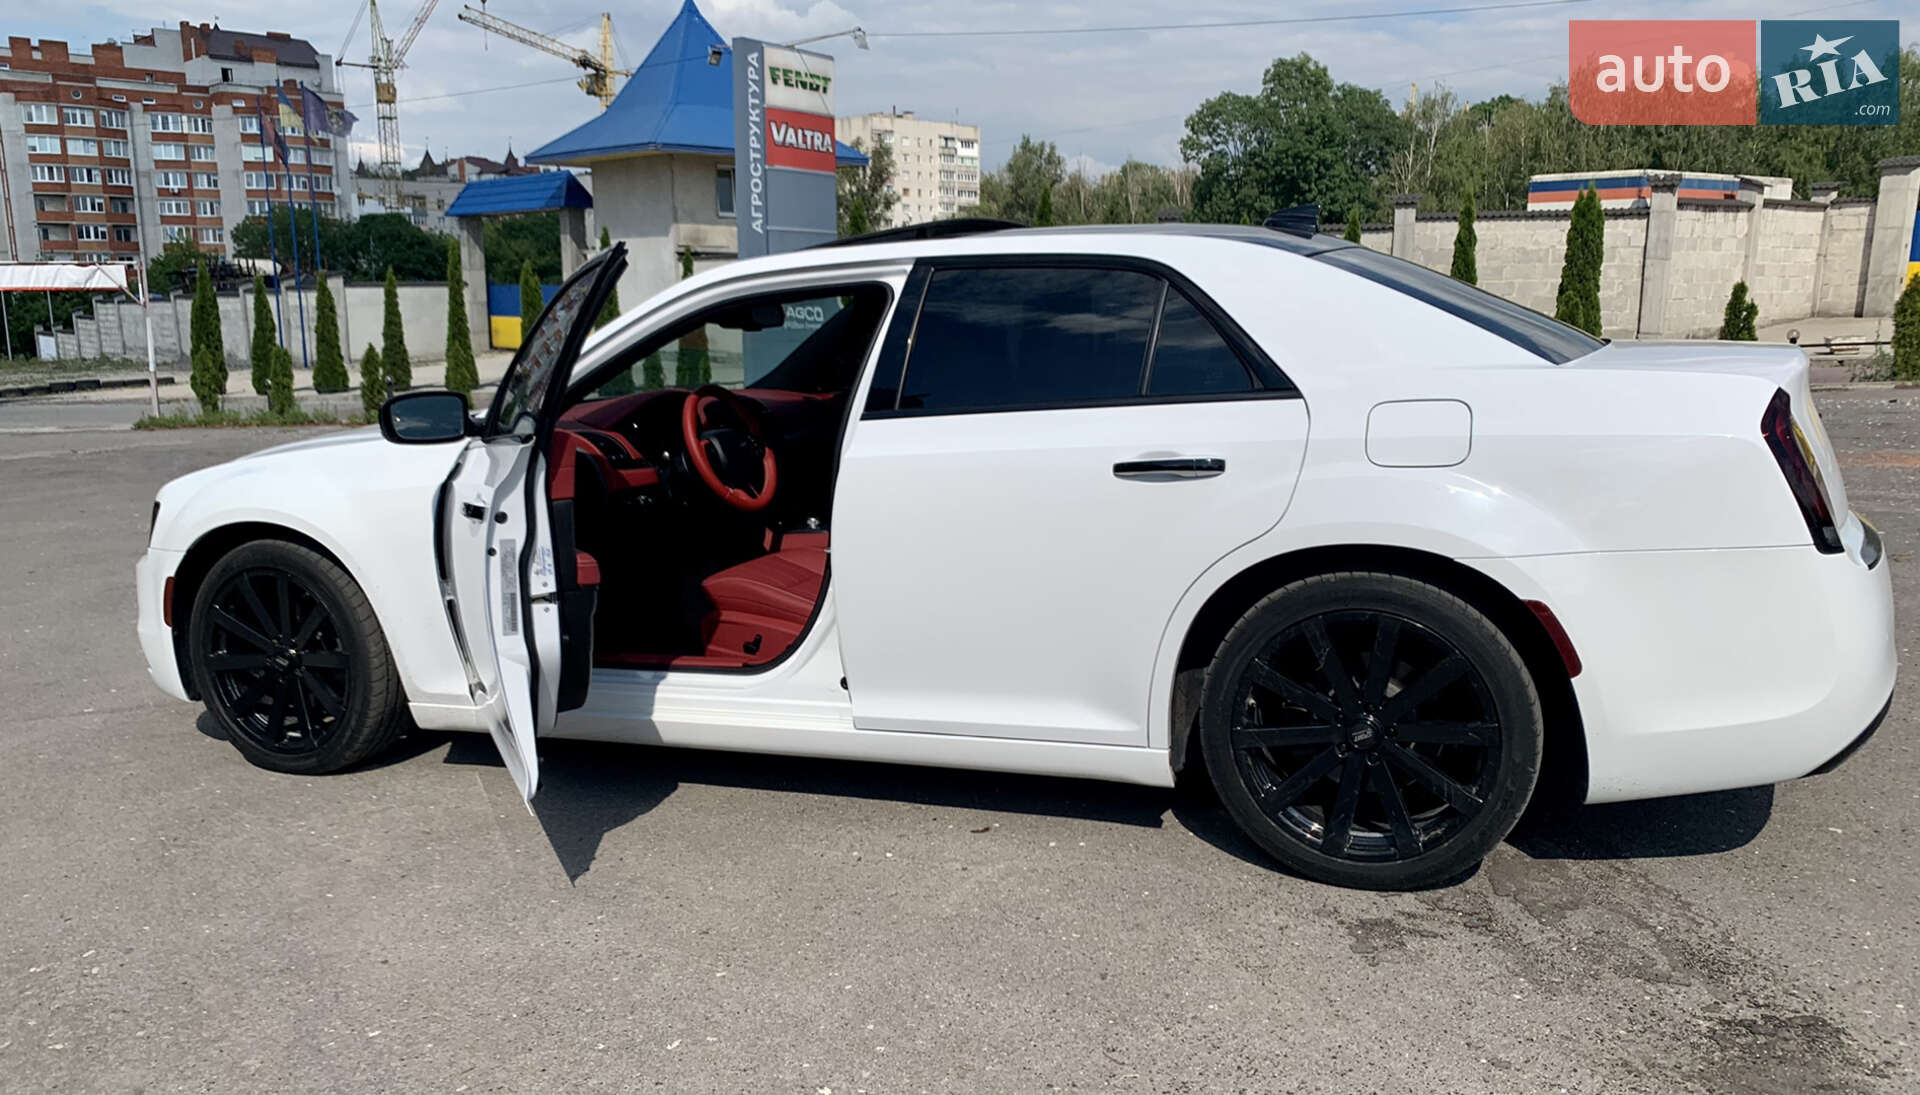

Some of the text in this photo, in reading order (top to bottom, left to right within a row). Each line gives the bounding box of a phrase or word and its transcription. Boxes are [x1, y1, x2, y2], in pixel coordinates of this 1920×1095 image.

[768, 66, 832, 95] FENDT
[747, 51, 764, 235] АГРОСТРУКТУРА
[769, 120, 833, 152] VALTRA
[786, 305, 824, 322] AGCO
